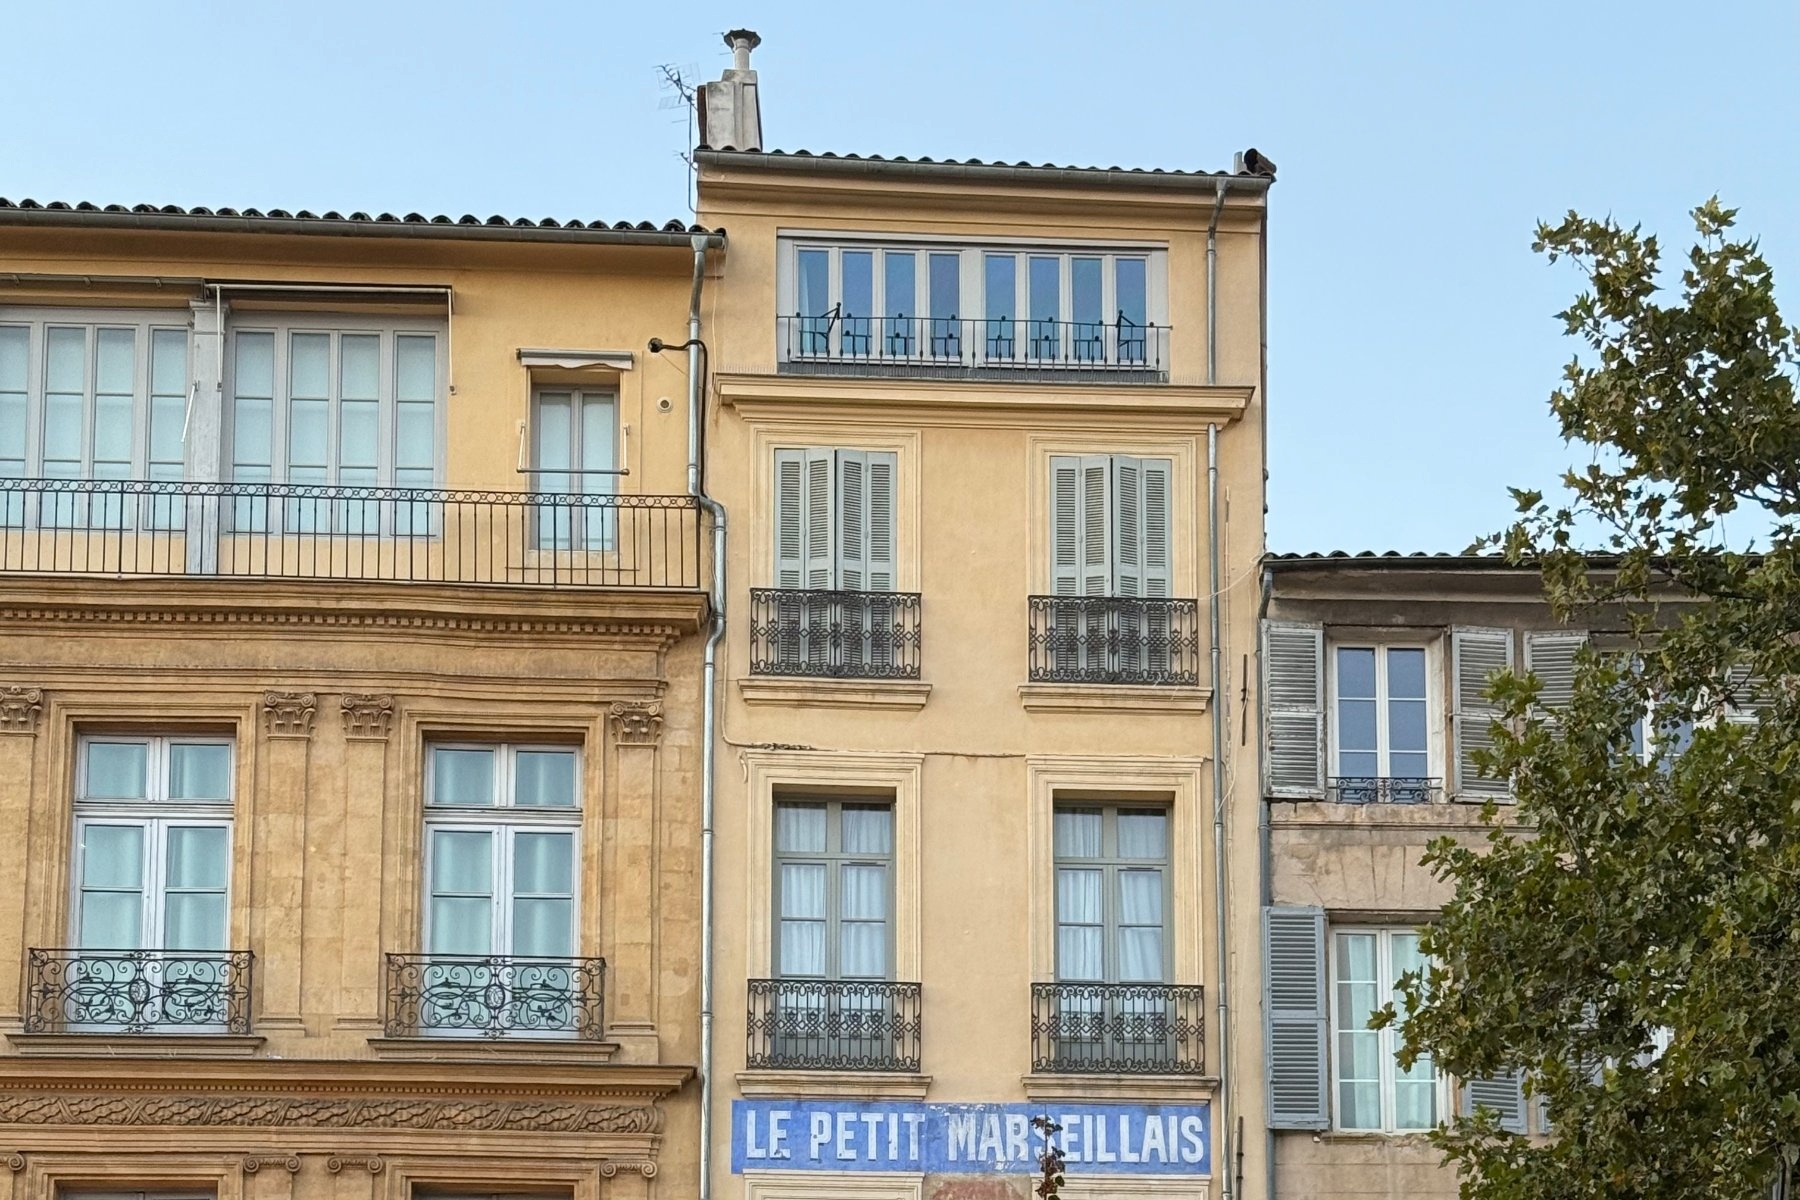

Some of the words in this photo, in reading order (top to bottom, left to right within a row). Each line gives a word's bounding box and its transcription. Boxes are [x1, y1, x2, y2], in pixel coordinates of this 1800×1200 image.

[746, 1110, 792, 1159] LE
[810, 1111, 926, 1161] PETIT
[948, 1113, 1204, 1163] MARSEILLAIS
